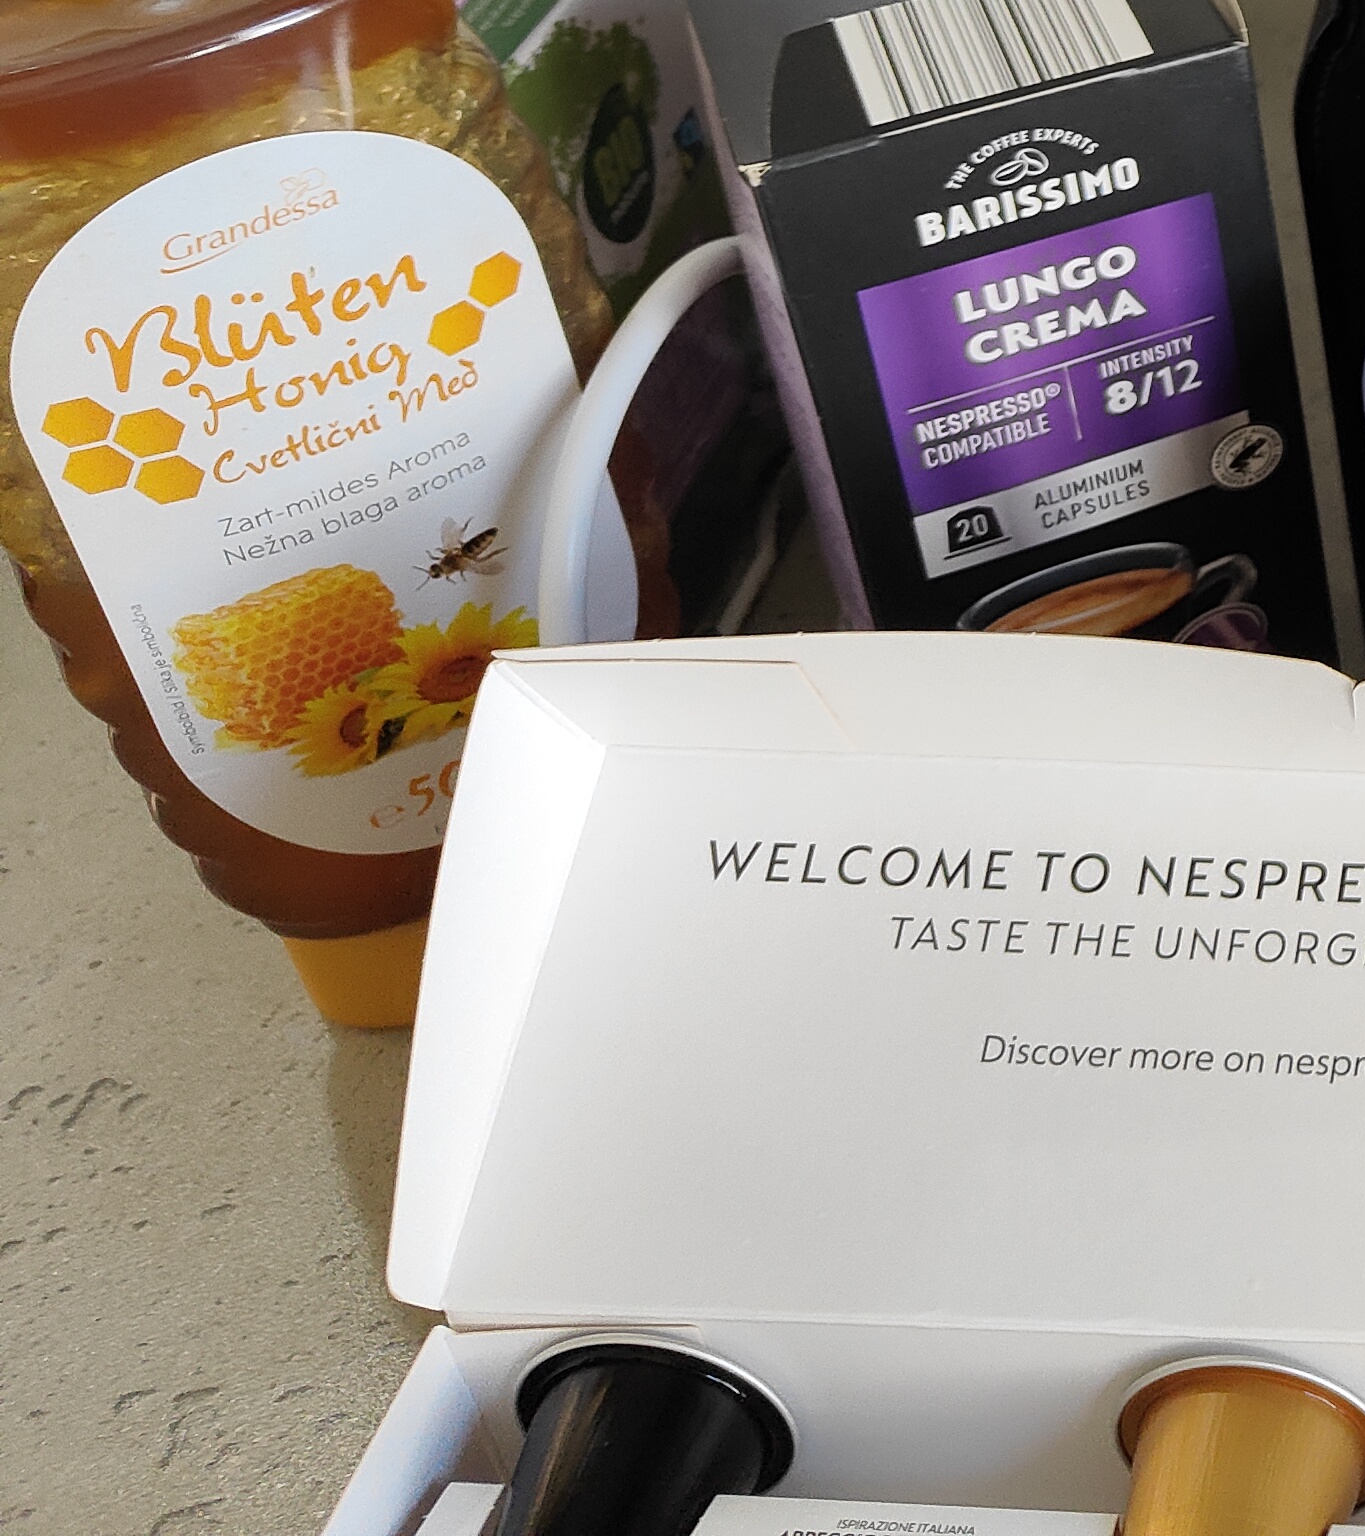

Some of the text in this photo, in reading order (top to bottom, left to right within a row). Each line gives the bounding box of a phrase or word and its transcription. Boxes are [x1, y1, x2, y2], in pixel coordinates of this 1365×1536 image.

[944, 128, 1100, 190] THE COFFEE EXPERTS
[163, 189, 340, 262] Grandessa
[914, 156, 1141, 248] BARISSIMO
[954, 244, 1137, 325] LUNGO
[85, 254, 427, 393] Blüten
[965, 288, 1148, 365] CREMA
[1099, 334, 1194, 380] INTENSITY
[1104, 358, 1203, 415] 8/12
[188, 338, 413, 436] Honig
[213, 359, 480, 484] Cvetlični Med
[921, 413, 1053, 470] COMPATIBLE
[218, 431, 472, 538] Zart-mildes Aroma
[223, 453, 488, 566] Nežna blaga aroma
[1034, 459, 1145, 510] ALUMINIUM
[1041, 480, 1151, 529] CAPSULES
[954, 513, 990, 543] 20
[709, 839, 1014, 891] WELCOME
[1036, 851, 1111, 895] TO
[890, 916, 1030, 954] TASTE
[1046, 921, 1136, 958] THE
[979, 1034, 1123, 1069] Discover
[1128, 1048, 1214, 1072] more
[1223, 1051, 1266, 1074] on
[836, 1519, 916, 1533] ISPIRAZIONE
[917, 1522, 976, 1536] ITALIANA
